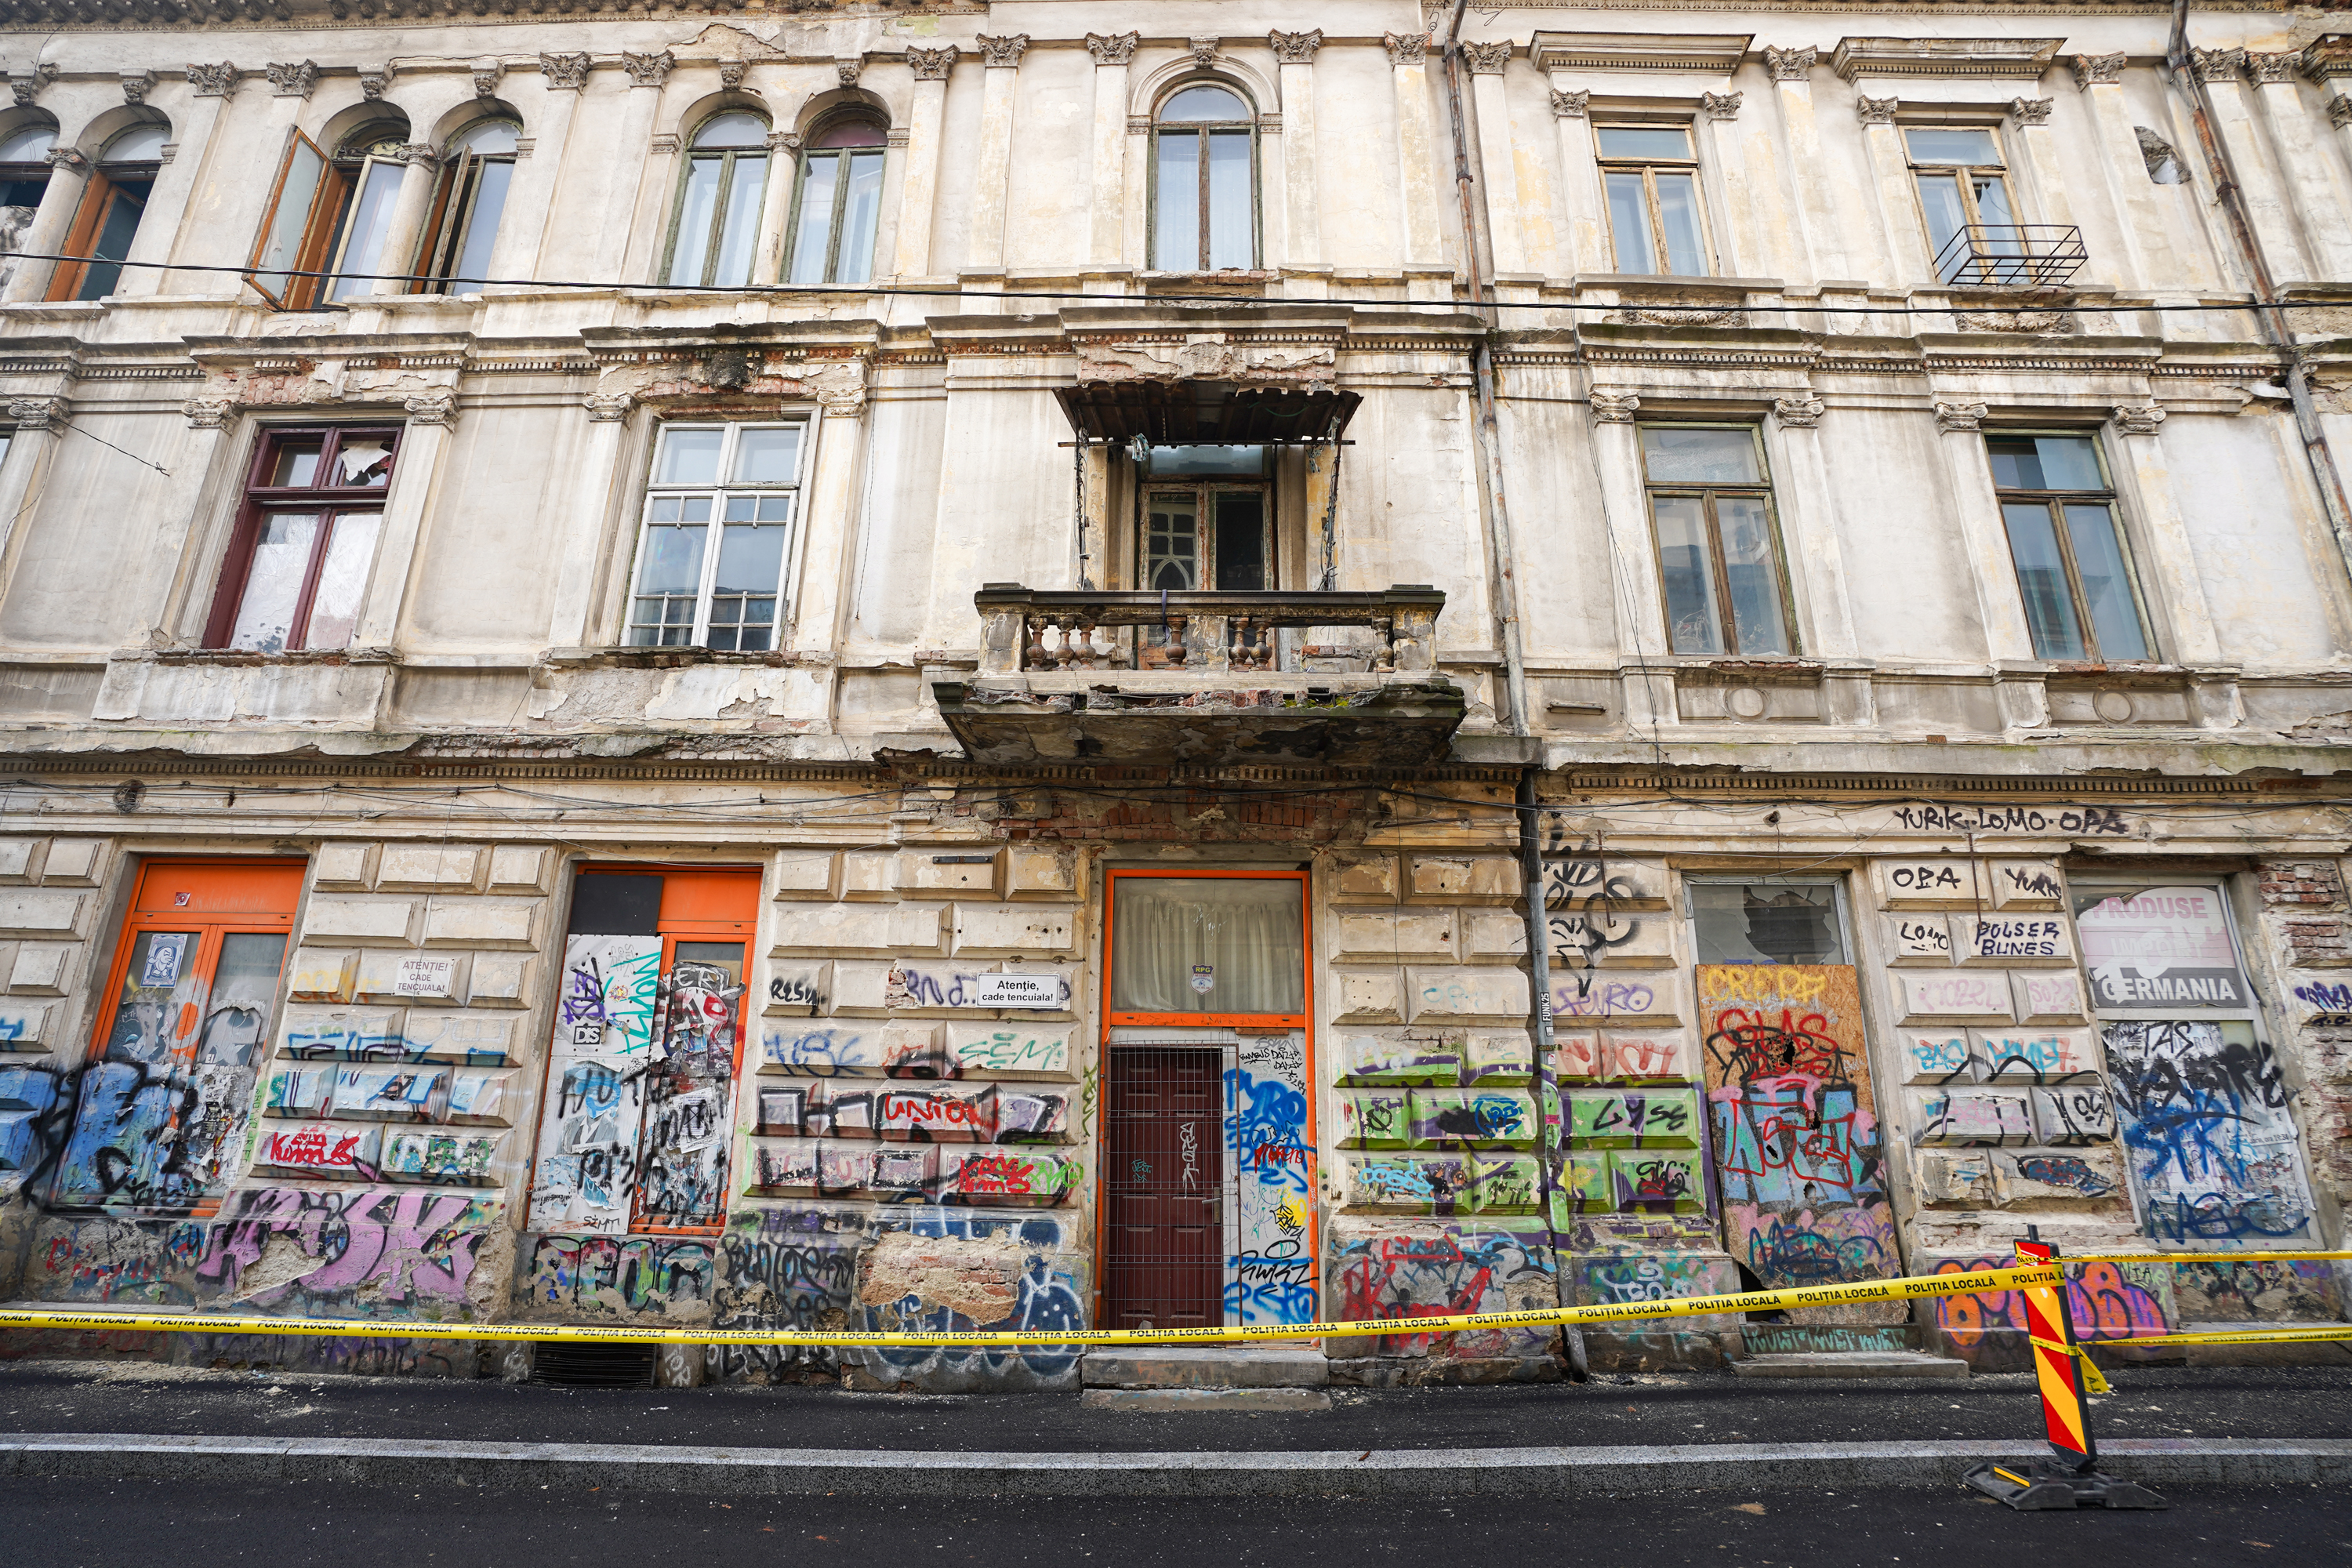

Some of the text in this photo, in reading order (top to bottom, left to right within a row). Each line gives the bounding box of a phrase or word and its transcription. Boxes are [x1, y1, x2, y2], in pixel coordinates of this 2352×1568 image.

[2092, 897, 2209, 920] PRODUSE
[402, 961, 448, 973] ATENȚIE!
[397, 982, 445, 993] TENCUIALA!
[982, 993, 1054, 1002] cade tencuiala!
[2101, 977, 2238, 1004] GERMANIA
[1541, 993, 1552, 1022] FUNK25
[1129, 1330, 1176, 1340] POLIȚIA
[1243, 1325, 1289, 1336] POLIȚIA
[1356, 1321, 1402, 1331] POLIȚIA
[1404, 1318, 1450, 1327] LOCALĂ
[1467, 1314, 1513, 1326] POLIȚIA
[1515, 1310, 1562, 1322] LOCALĂ
[1577, 1307, 1624, 1319] POLIȚIA
[1626, 1302, 1672, 1315] LOCALĂ
[1688, 1298, 1733, 1311] POLIȚIA
[1736, 1294, 1781, 1308] LOCALĂ
[1797, 1290, 1842, 1303] POLIȚIA
[1844, 1285, 1889, 1299] LOCALĂ
[1905, 1281, 1950, 1295] POLIȚIA
[1954, 1276, 1997, 1290] LOCALĂ
[2012, 1272, 2056, 1285] POLIȚIA
